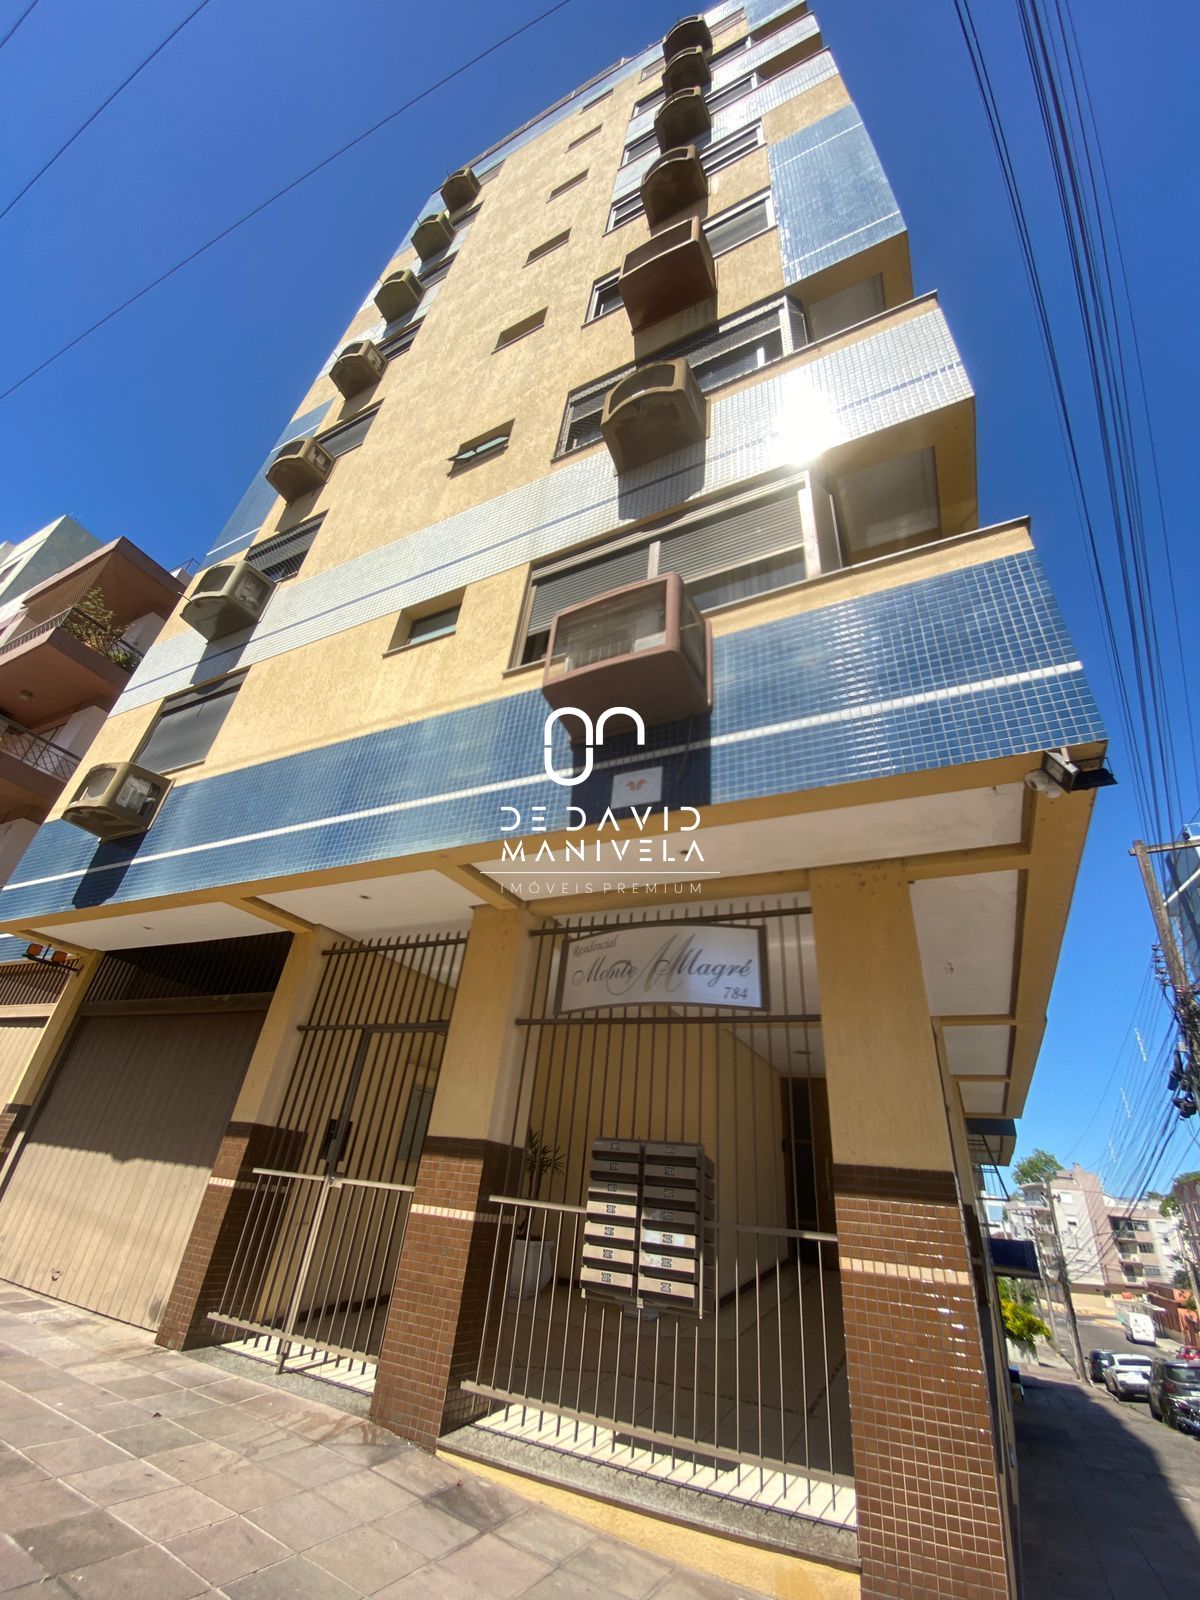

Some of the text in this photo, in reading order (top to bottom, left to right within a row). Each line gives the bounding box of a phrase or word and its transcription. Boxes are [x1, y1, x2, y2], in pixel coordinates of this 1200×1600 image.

[572, 948, 753, 988] Monte Magré
[723, 986, 749, 1000] 784
